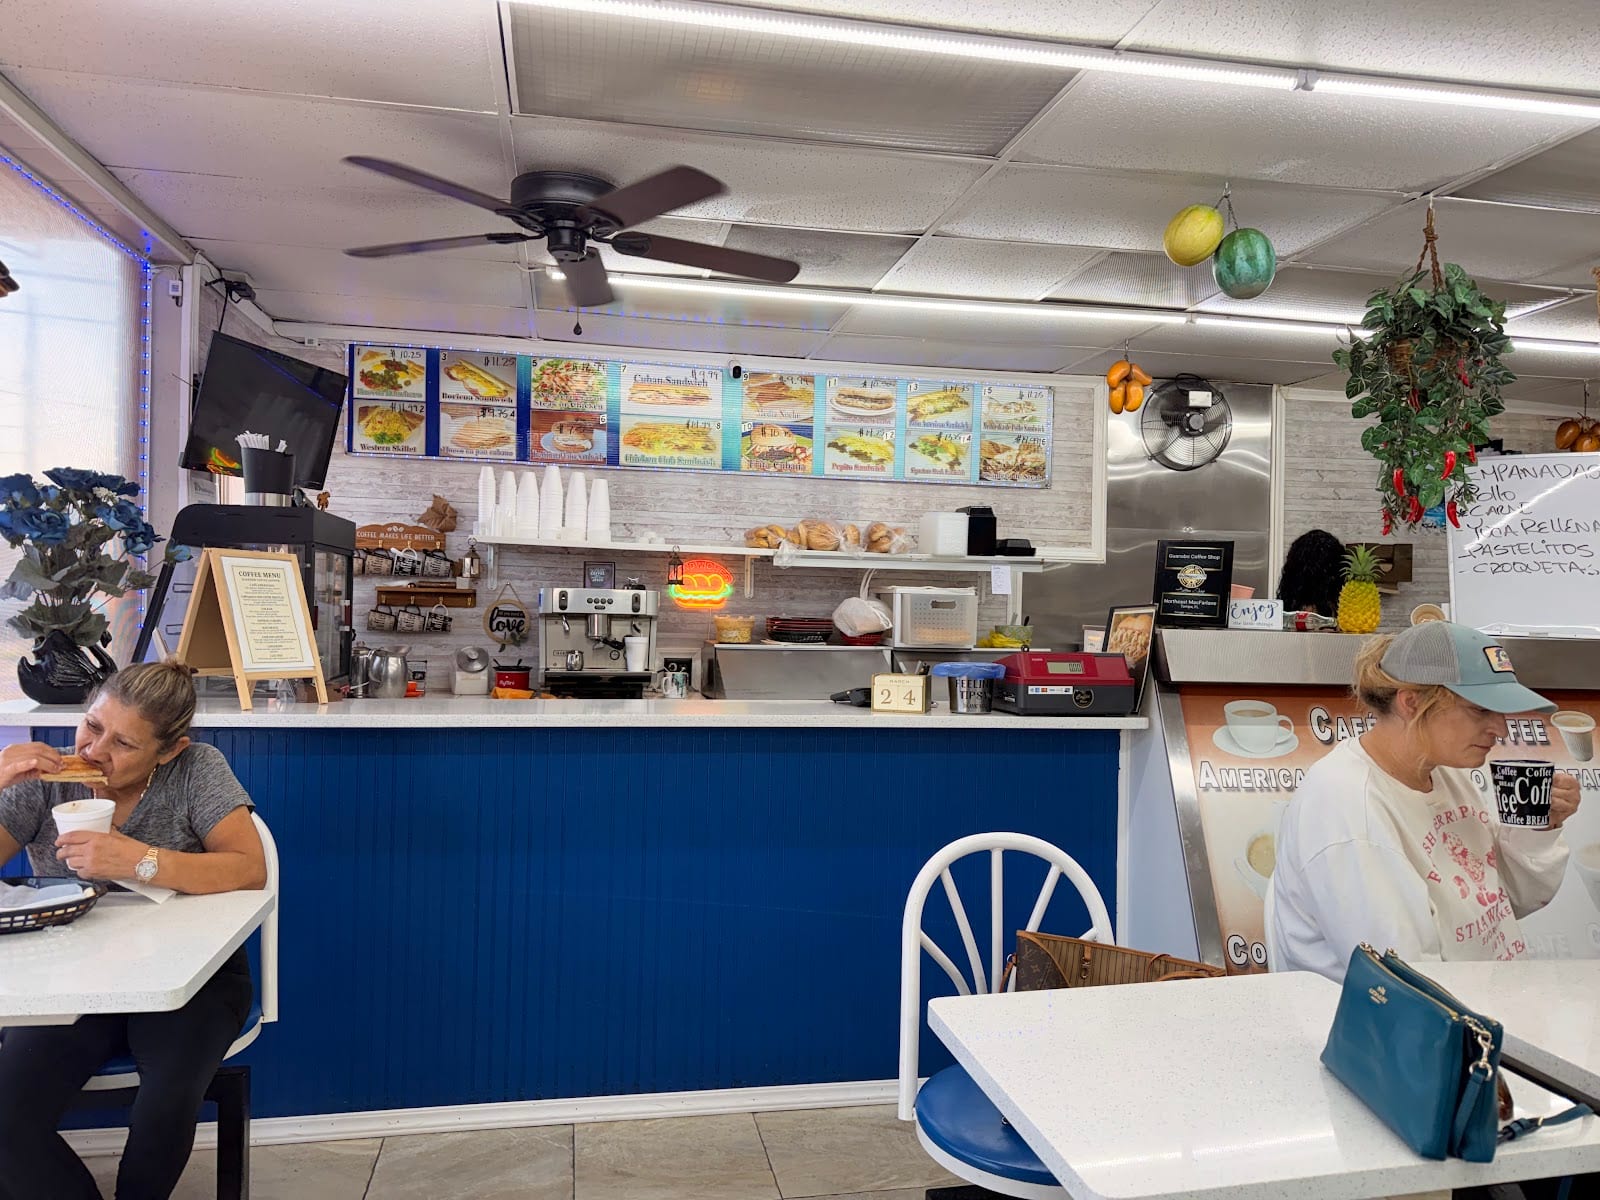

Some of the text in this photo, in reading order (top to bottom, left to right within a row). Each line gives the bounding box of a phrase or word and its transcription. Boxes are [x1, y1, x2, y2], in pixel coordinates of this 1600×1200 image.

[441, 351, 447, 361] 3
[532, 359, 538, 367] 5
[633, 374, 708, 387] Cuban Sandwich
[908, 382, 919, 392] 13
[983, 386, 993, 396] 15
[359, 443, 418, 453] Western Skillet
[356, 531, 377, 539] COFFEE
[379, 532, 399, 540] MAKES
[1231, 602, 1279, 621] Enjoy
[489, 606, 526, 633] love
[880, 688, 916, 705] 2 4
